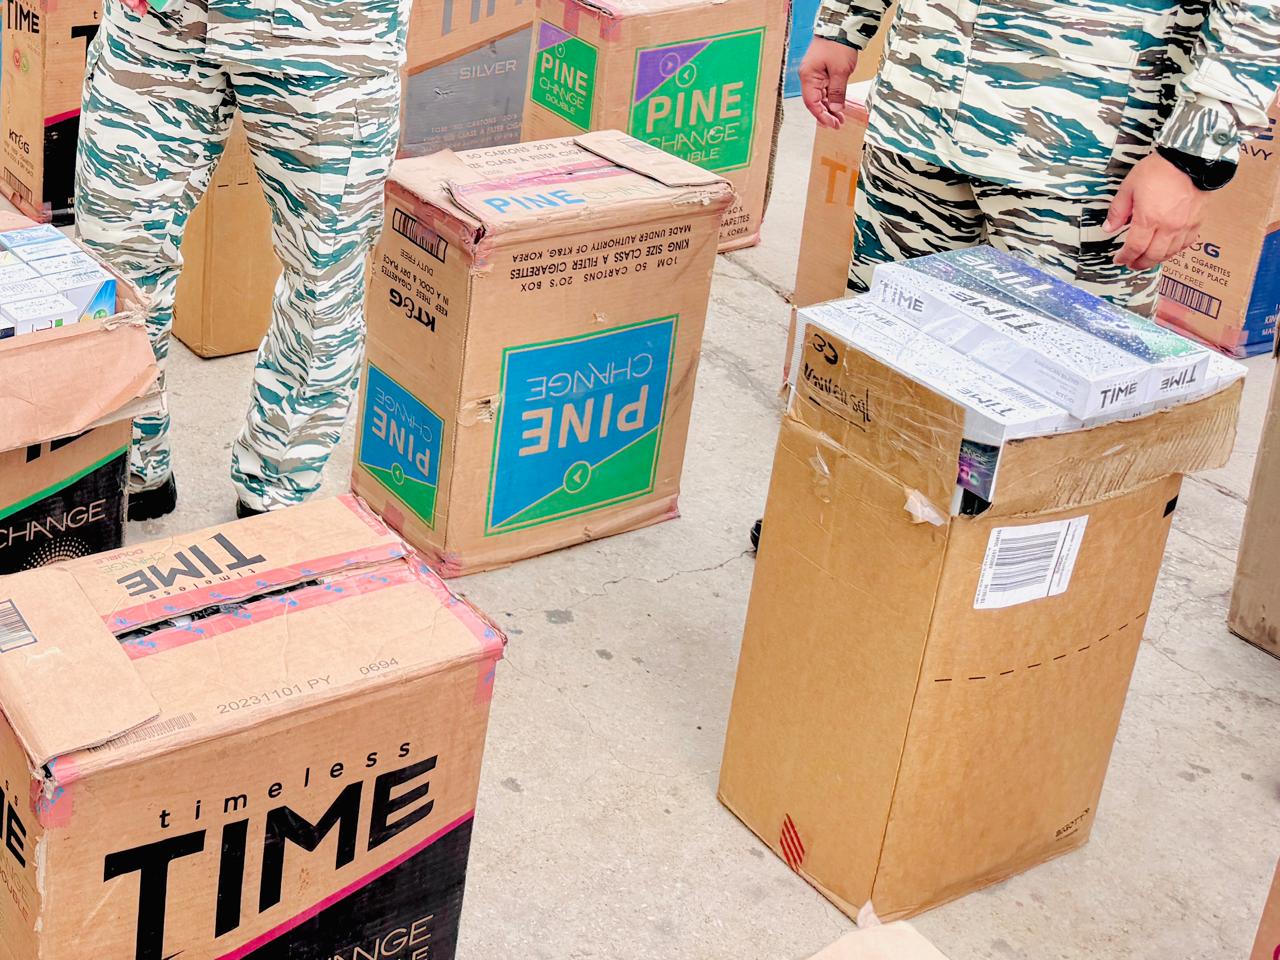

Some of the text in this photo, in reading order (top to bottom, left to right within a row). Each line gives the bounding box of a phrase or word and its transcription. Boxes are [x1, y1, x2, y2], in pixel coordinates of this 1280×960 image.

[459, 59, 518, 81] SILVER
[540, 52, 589, 97] PINE
[539, 77, 586, 110] CHANGE
[545, 93, 577, 116] DOUBLE
[646, 81, 745, 134] PINE
[8, 128, 31, 155] KT&G
[485, 145, 531, 160] CARTONS
[1240, 143, 1273, 161] AVY
[467, 160, 480, 170] IZE
[484, 157, 514, 170] CLASS
[518, 155, 527, 166] A
[530, 152, 557, 165] FILTER
[821, 156, 858, 208] TI
[482, 189, 586, 214] PINE
[512, 224, 692, 265] MADE UNDER AUTHORITY OF KT&G, KOREA
[727, 226, 749, 238] KOREA
[399, 266, 411, 279] DRY
[400, 248, 434, 277] DUTY FREE
[509, 238, 690, 280] KING SIZE CLASS A FILTER CIGARETTES
[634, 262, 648, 273] 50
[1190, 256, 1231, 279] CIGARETTES
[418, 278, 435, 295] COOL
[520, 280, 542, 293] BOX
[549, 276, 573, 288] 20'S
[583, 266, 628, 283] CARTONS
[955, 254, 1055, 295] TIME
[1162, 265, 1205, 289] DUTY FREE
[1191, 266, 1205, 279] DRY
[1207, 271, 1229, 288] PLACE
[381, 265, 448, 318] KEEP THESE CIGARETTES
[442, 296, 449, 306] IN
[879, 279, 925, 313] TIME
[389, 288, 436, 333] KT&G
[947, 290, 1043, 335] TIME
[526, 353, 654, 402] CHANGE
[1159, 365, 1198, 391] TIME
[956, 387, 1016, 419] TIME
[1100, 381, 1138, 410] TIME
[375, 386, 434, 444] CHANGE
[518, 384, 650, 458] PINE
[371, 405, 432, 478] PINE
[94, 548, 144, 565] DOUBLE
[116, 532, 267, 597] TIME
[149, 568, 256, 600] timeless
[217, 656, 400, 717] 20231101 PY 0694
[158, 740, 412, 829] timeless
[103, 755, 439, 960] TIME
